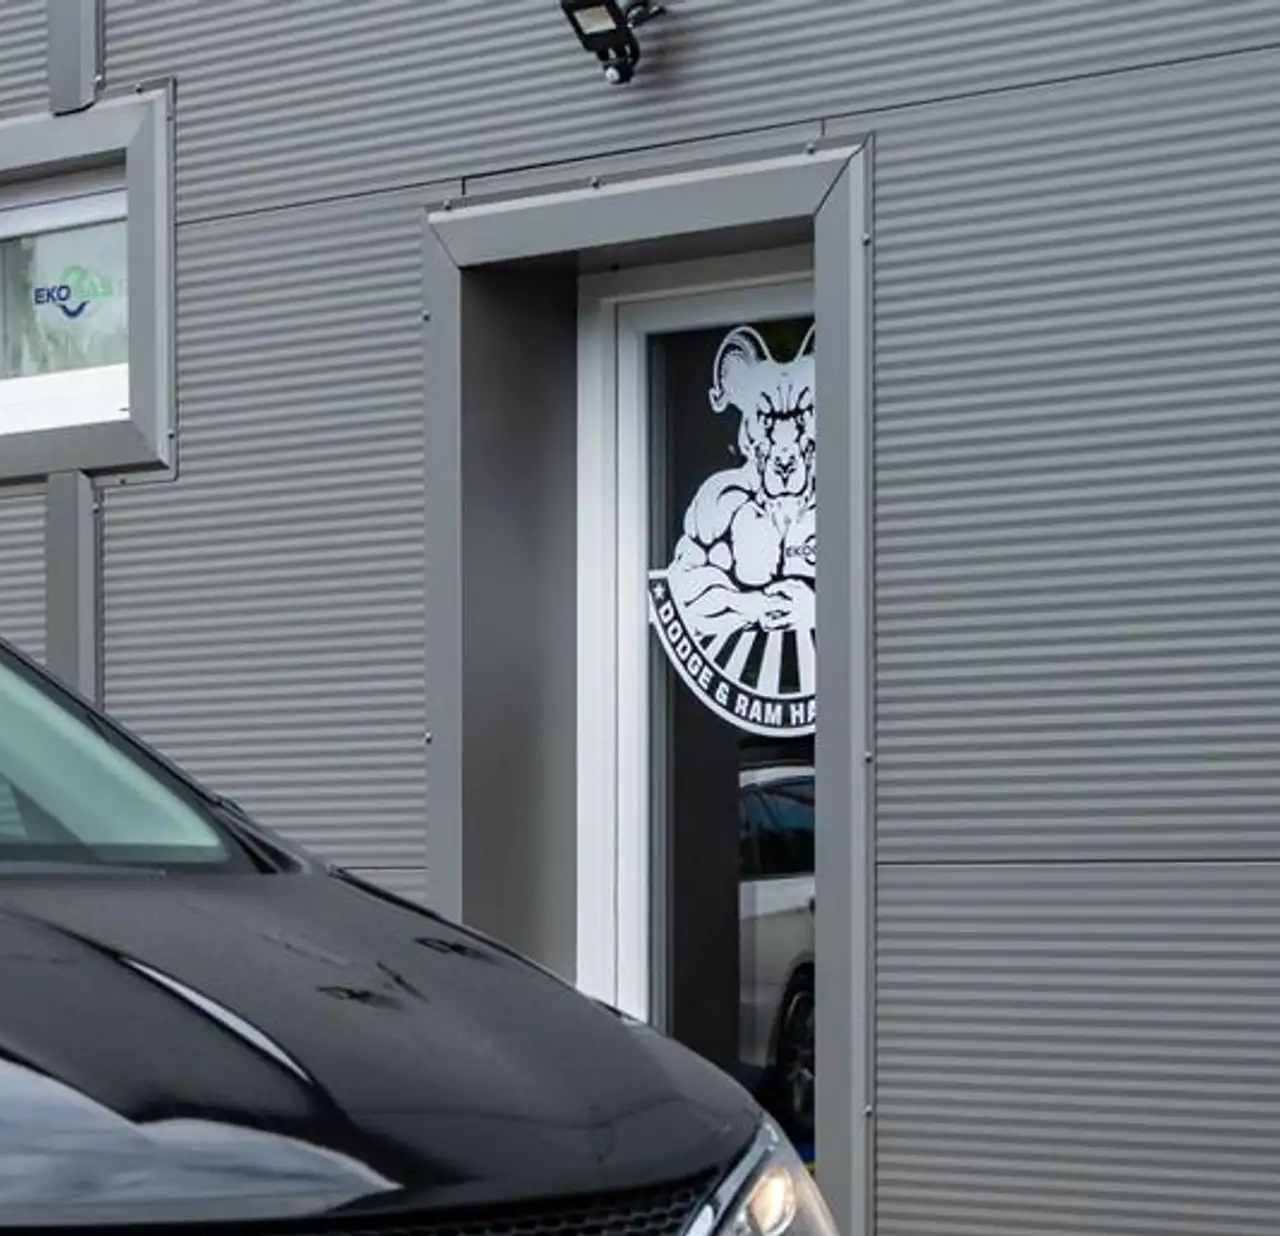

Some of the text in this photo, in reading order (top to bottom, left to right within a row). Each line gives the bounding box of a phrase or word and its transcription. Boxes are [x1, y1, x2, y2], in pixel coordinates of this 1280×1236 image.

[658, 599, 714, 690] DODGE
[715, 681, 730, 706] &
[734, 692, 783, 726] RAM
